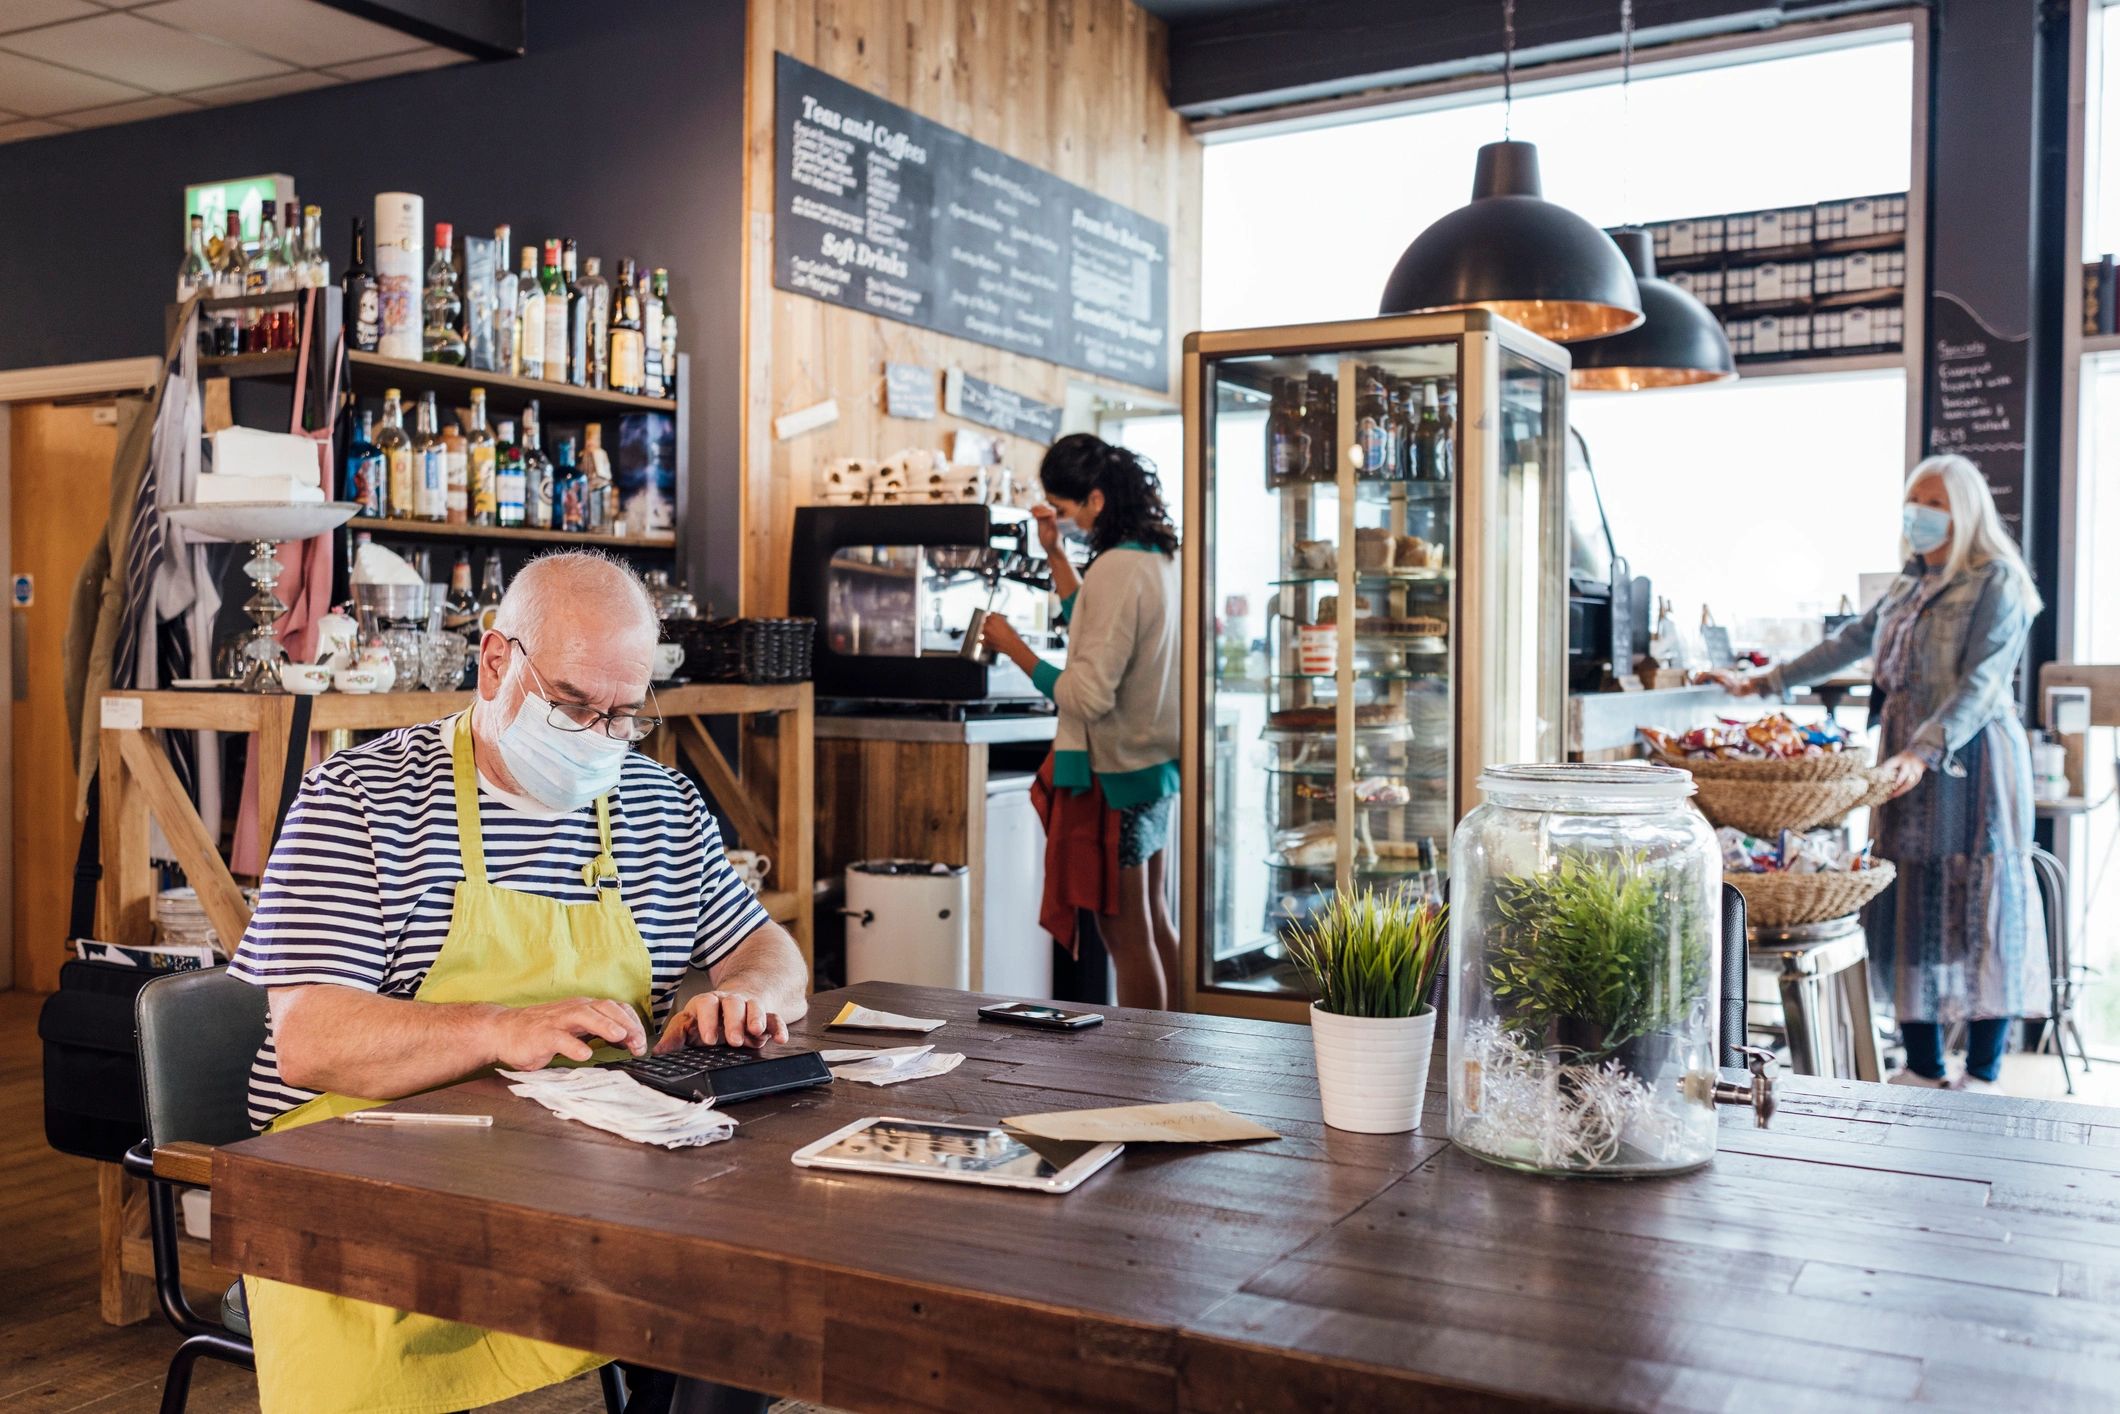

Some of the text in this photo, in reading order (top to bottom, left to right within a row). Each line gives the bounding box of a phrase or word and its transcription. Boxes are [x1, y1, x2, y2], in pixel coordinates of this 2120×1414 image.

[802, 95, 842, 131] Teas
[842, 117, 874, 144] and
[874, 125, 927, 165] Coffees
[821, 232, 856, 266] Soft
[856, 242, 908, 279] Drinks
